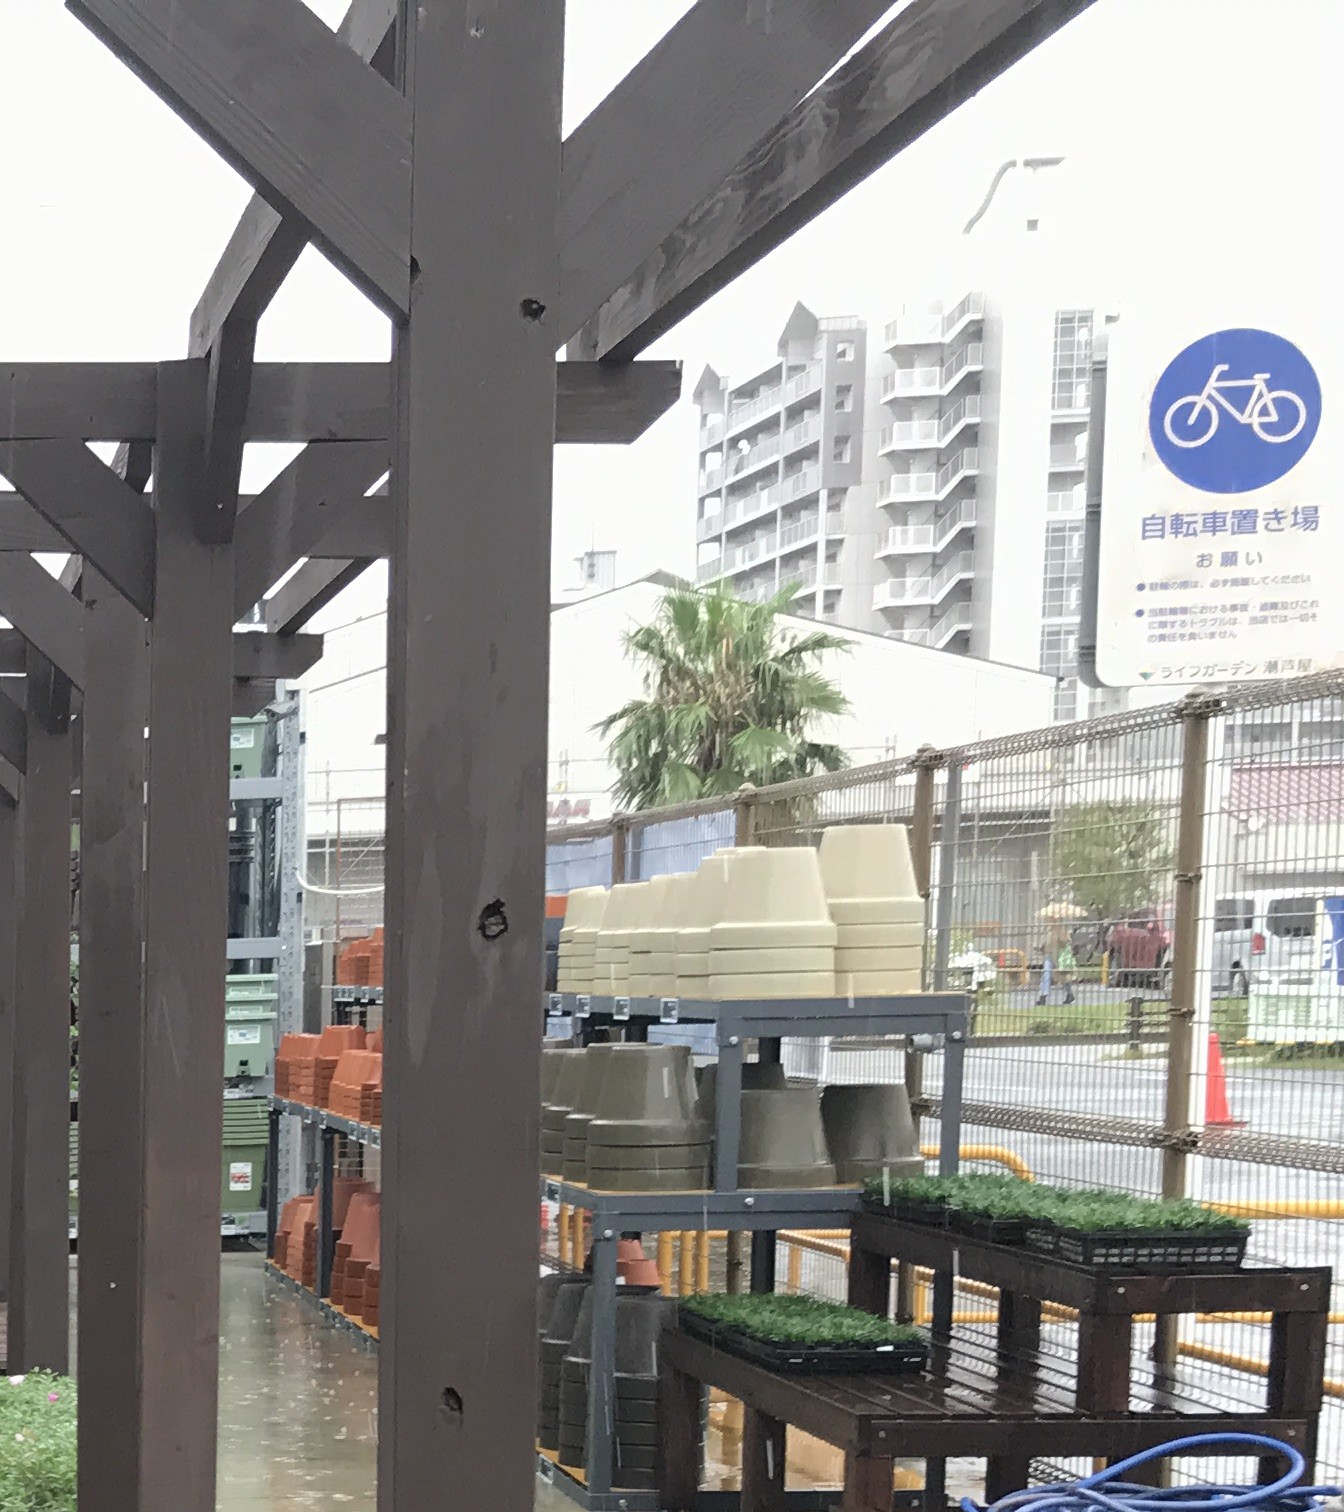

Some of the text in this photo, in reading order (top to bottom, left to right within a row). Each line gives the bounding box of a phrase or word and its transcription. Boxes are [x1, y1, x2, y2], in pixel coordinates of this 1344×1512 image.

[1141, 505, 1320, 540] 自転車置き場
[1195, 551, 1263, 568] お願い
[1161, 660, 1258, 679] ライフガーデン
